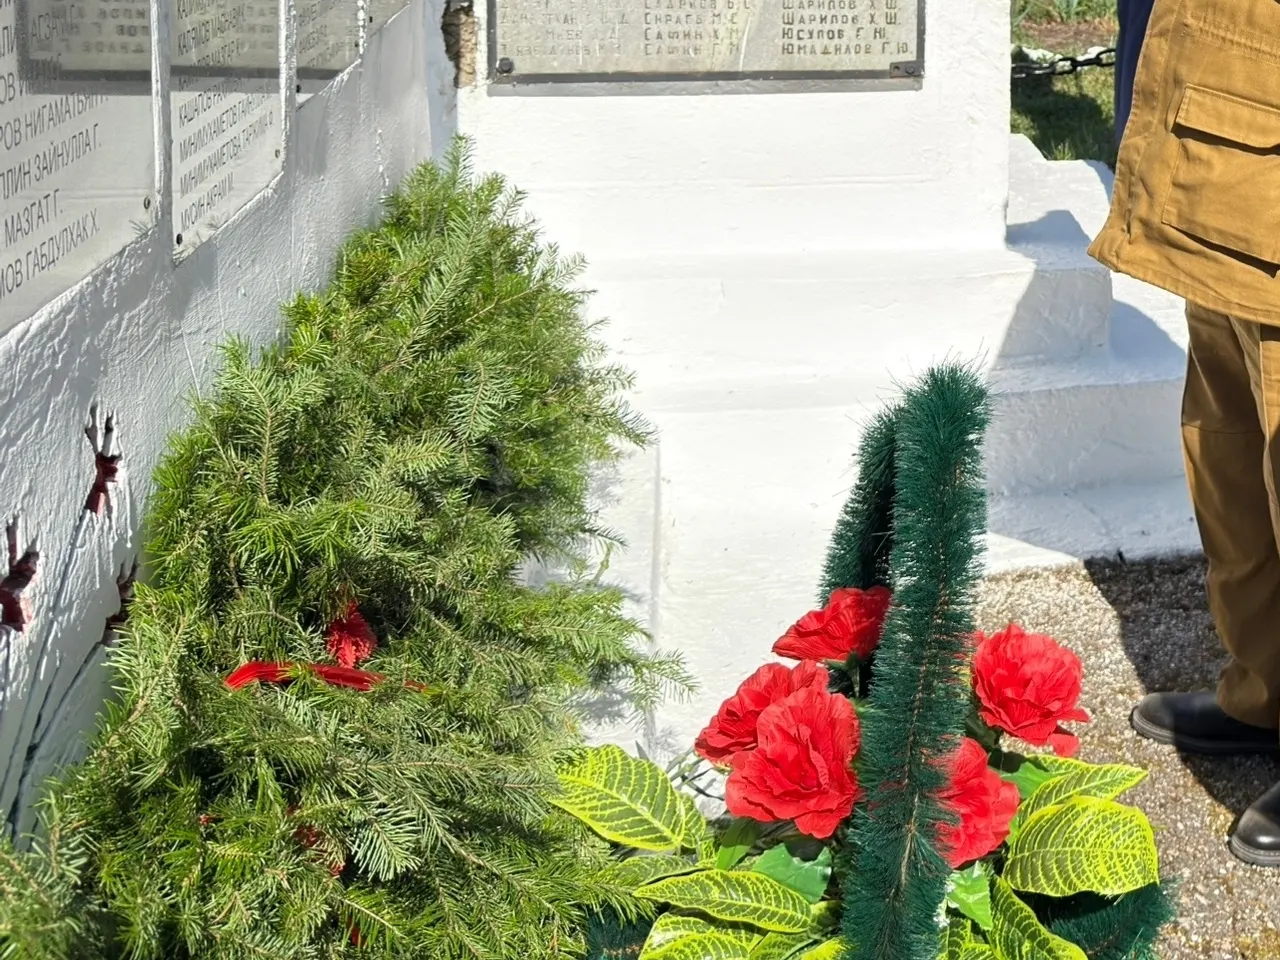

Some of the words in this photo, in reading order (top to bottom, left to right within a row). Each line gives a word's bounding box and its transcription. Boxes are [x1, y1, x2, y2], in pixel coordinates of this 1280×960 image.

[781, 11, 858, 25] ШАРИПОВ
[781, 27, 844, 40] ЮСУПОВ
[781, 42, 871, 55] ЮМАДИЛОВ
[34, 123, 91, 183] ЗАЙНУЛЛА
[4, 190, 53, 248] МАЗГАТ
[180, 191, 204, 238] МУСИН
[25, 213, 88, 283] ГАБДУЛХАК
